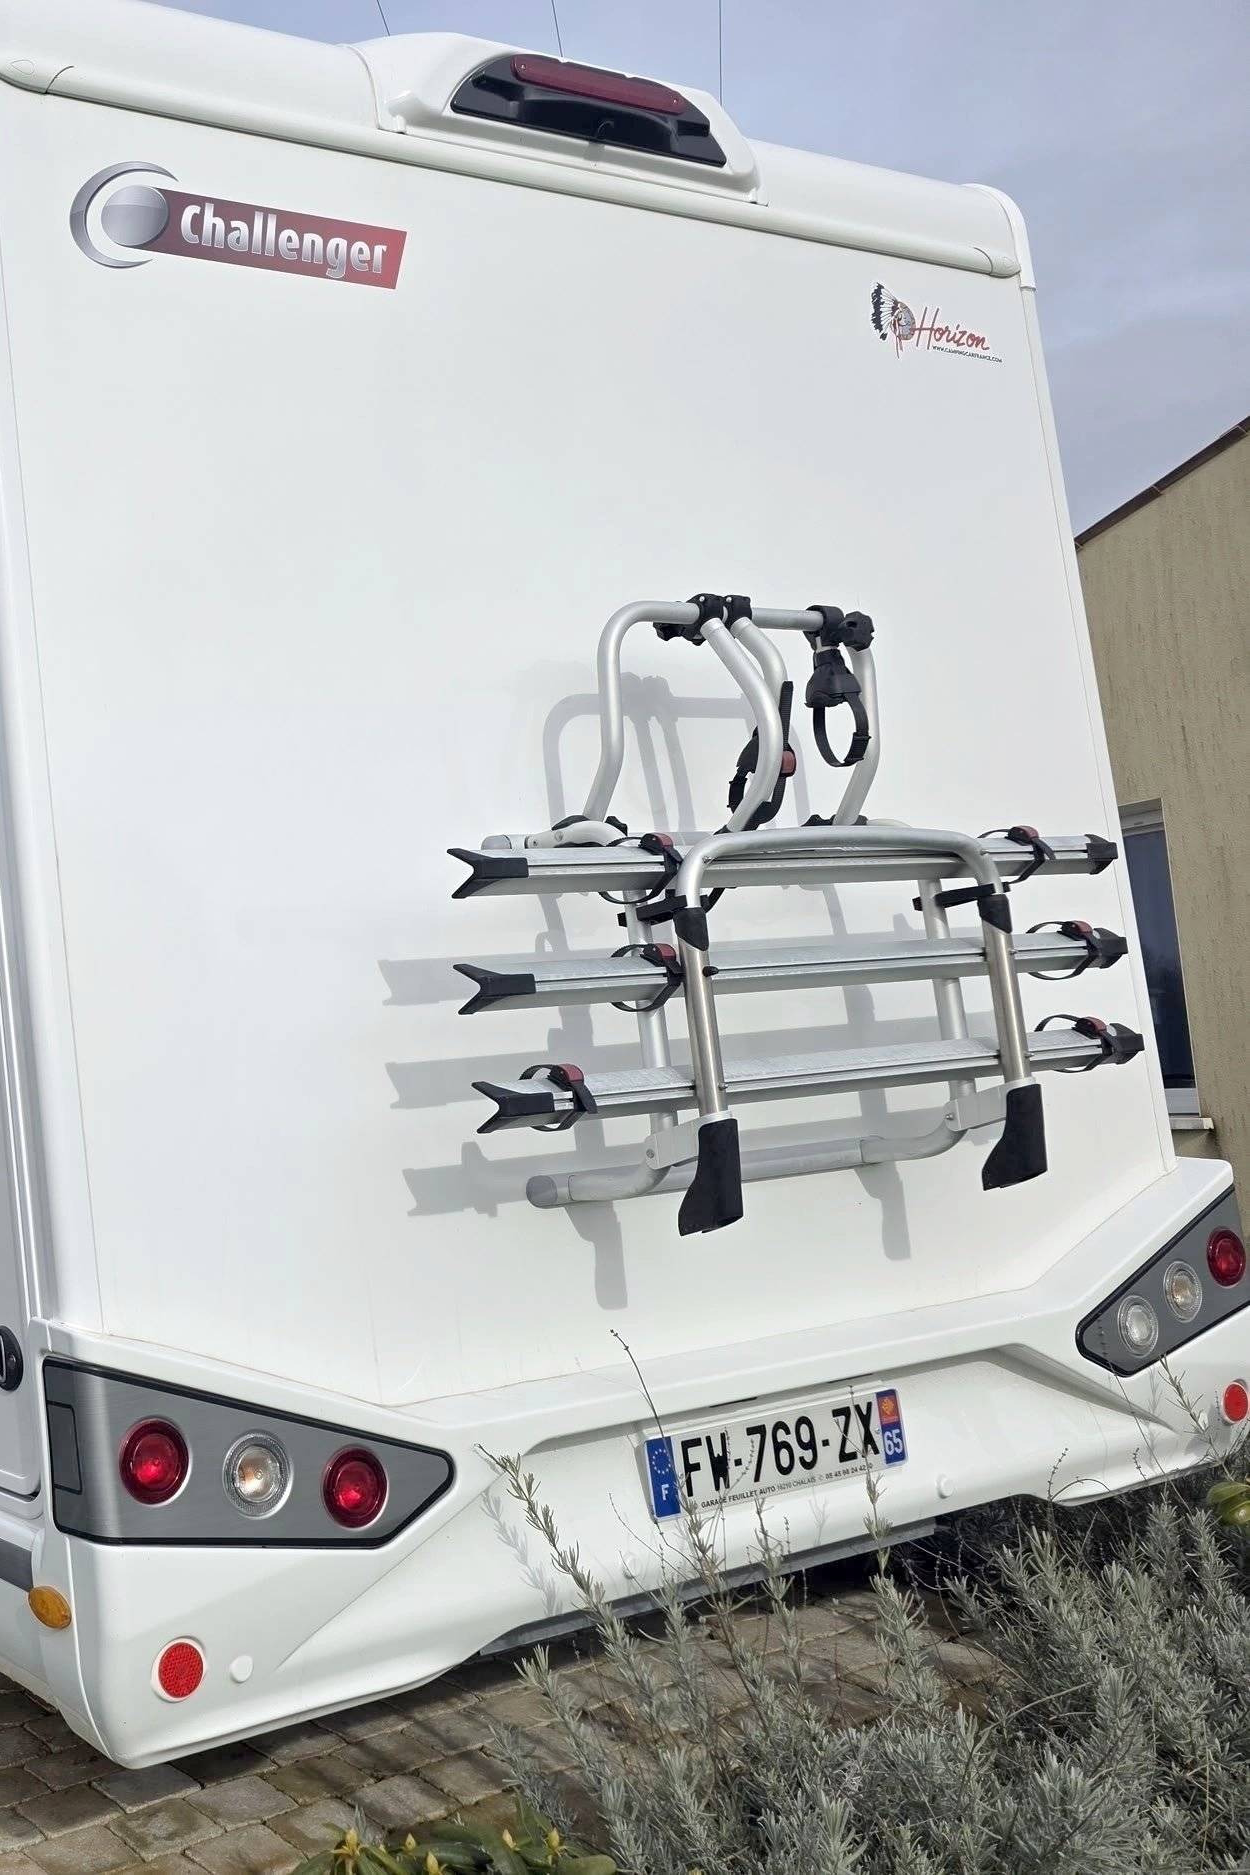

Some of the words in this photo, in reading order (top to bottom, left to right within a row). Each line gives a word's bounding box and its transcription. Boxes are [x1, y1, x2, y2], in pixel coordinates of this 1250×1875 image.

[180, 203, 388, 279] Challenger
[913, 306, 991, 351] Horizon
[680, 1401, 881, 1497] FW-769-ZX
[884, 1428, 903, 1456] 65
[661, 1484, 670, 1501] F
[701, 1496, 727, 1509] GARAGE
[728, 1490, 758, 1504] FEUILLET
[759, 1485, 776, 1497] AUTO
[792, 1475, 816, 1488] CHALAIS
